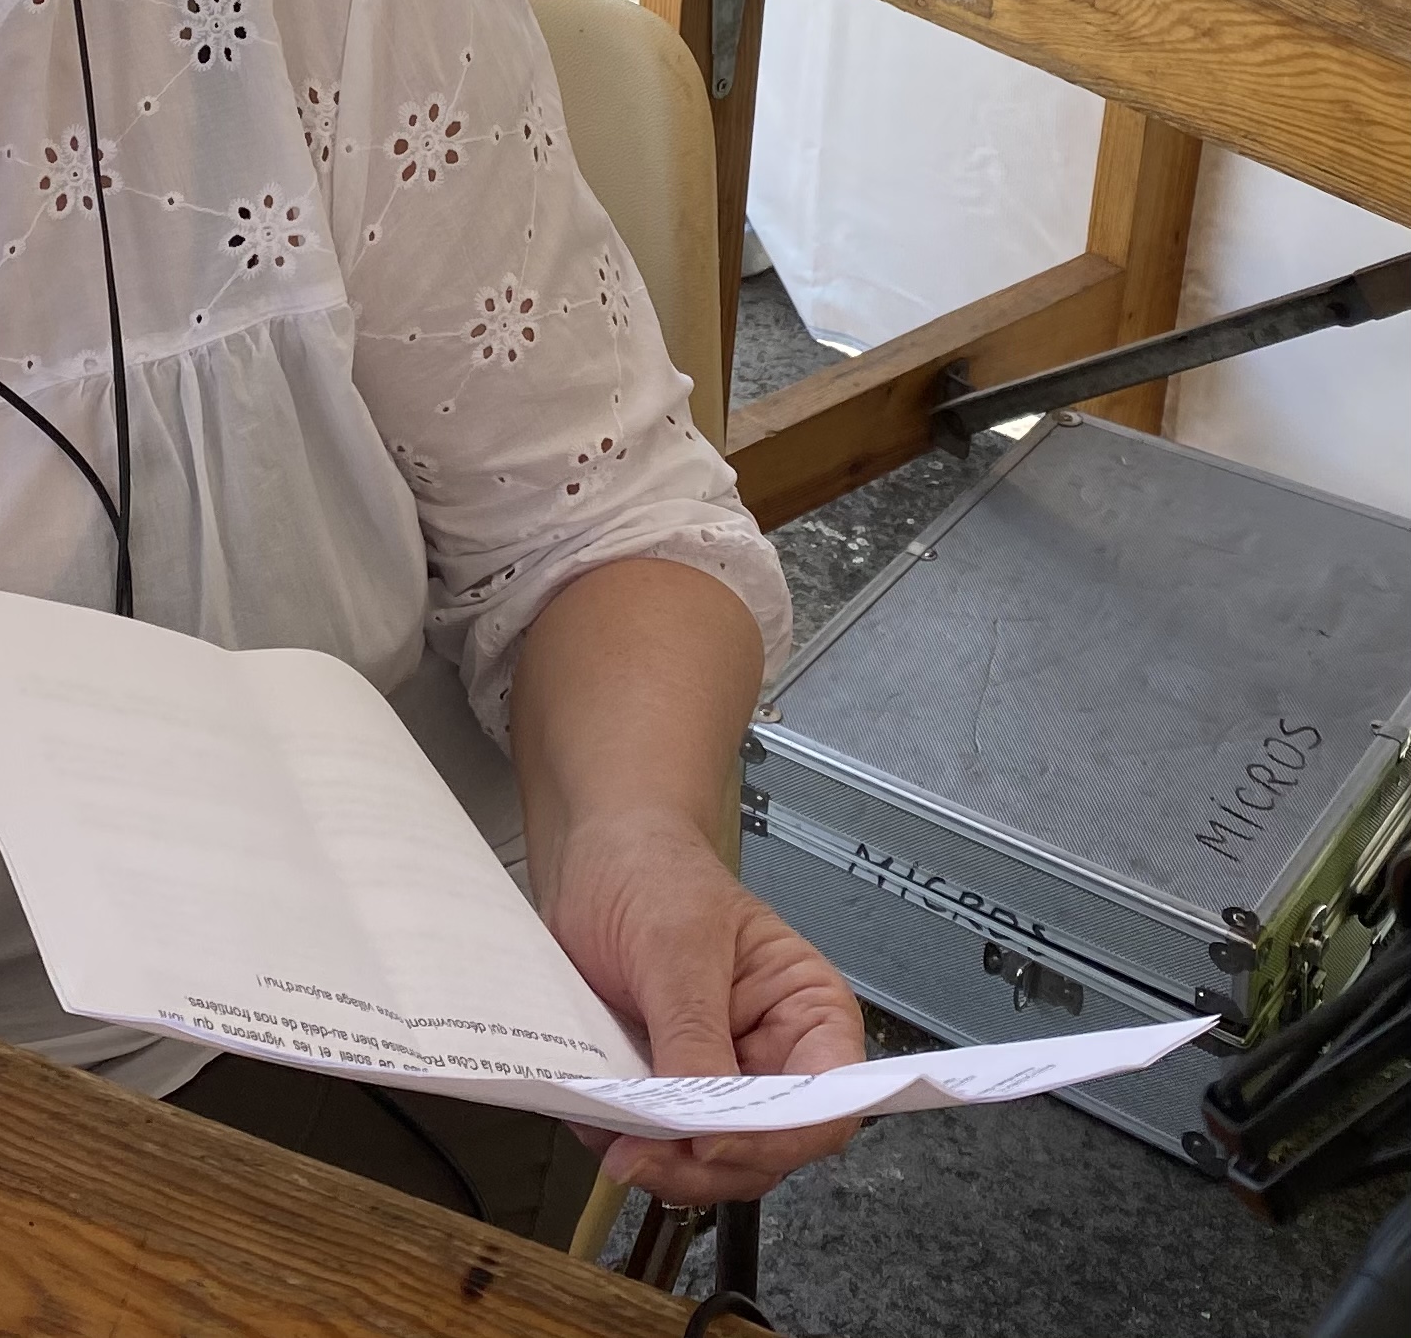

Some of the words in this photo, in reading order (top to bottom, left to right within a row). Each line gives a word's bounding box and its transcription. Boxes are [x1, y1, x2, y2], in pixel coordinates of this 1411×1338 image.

[253, 1010, 278, 1025] nos
[281, 1017, 297, 1032] de
[221, 1023, 286, 1049] vignerons
[488, 1022, 508, 1036] qui
[351, 1032, 380, 1050] bien
[540, 1032, 568, 1049] tous
[480, 1058, 494, 1073] la
[495, 1061, 511, 1075] de
